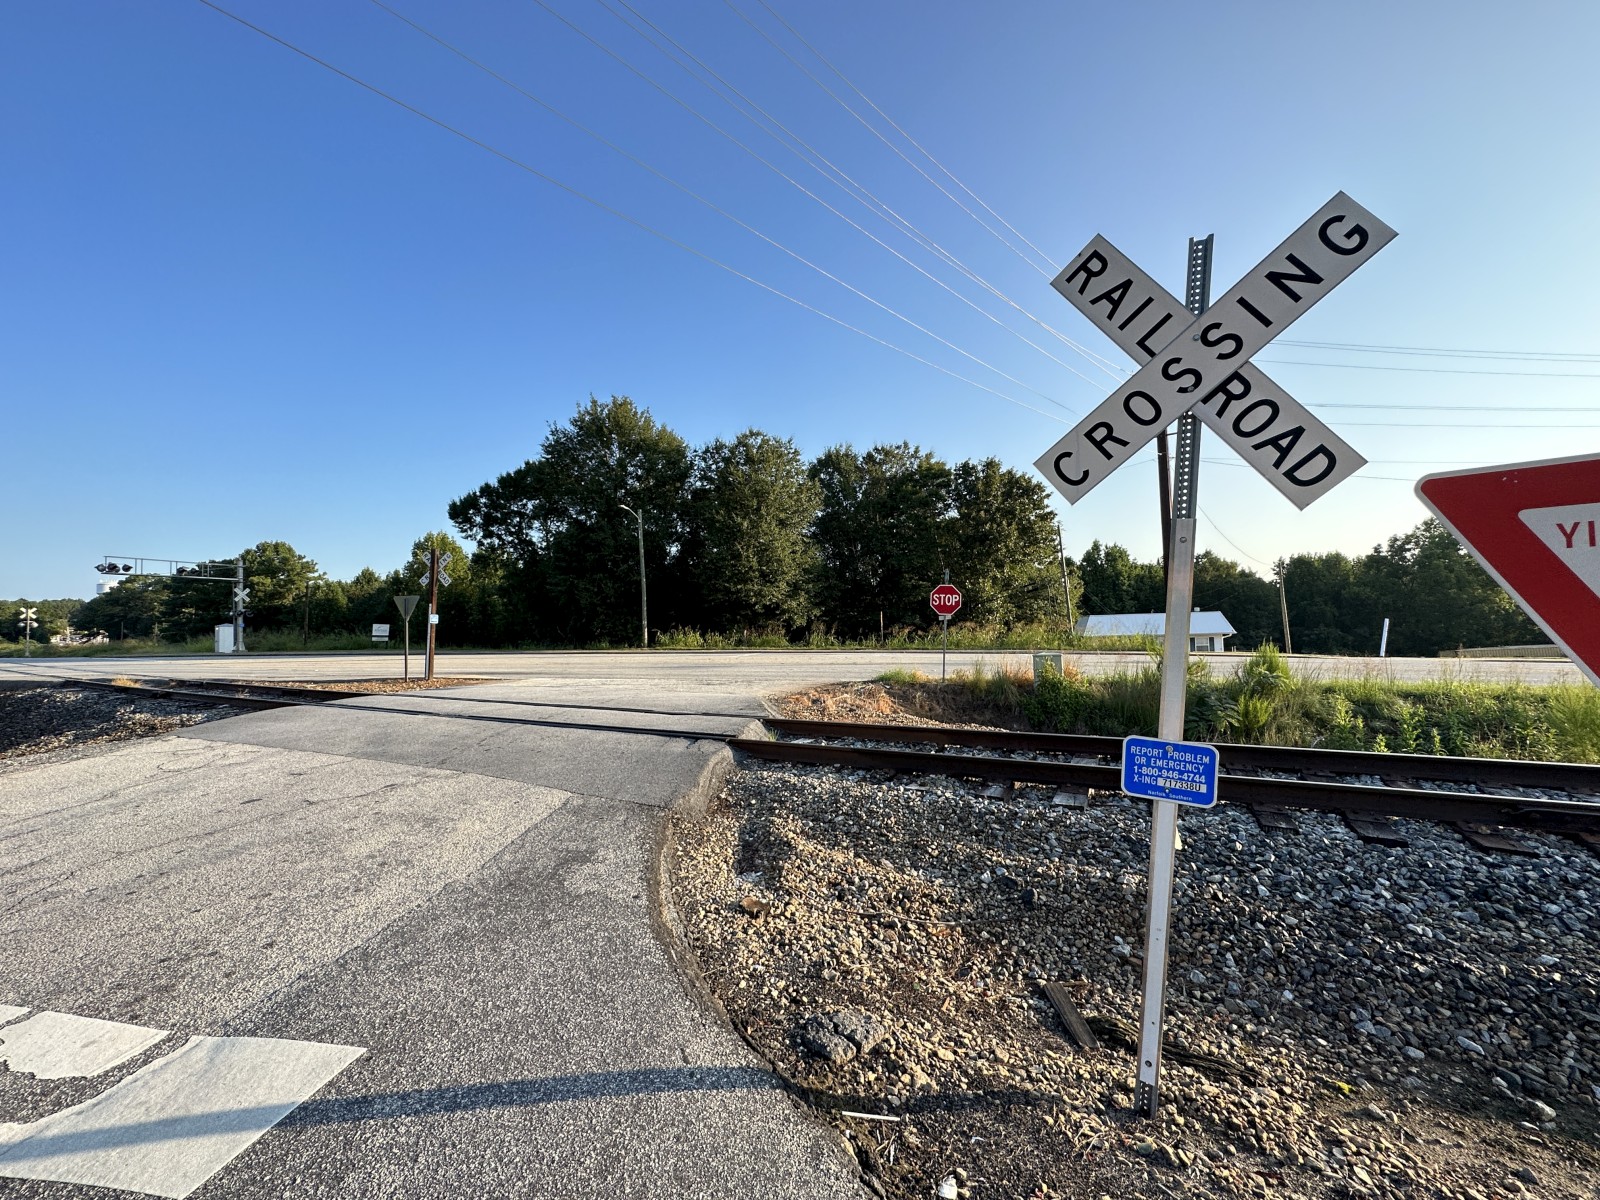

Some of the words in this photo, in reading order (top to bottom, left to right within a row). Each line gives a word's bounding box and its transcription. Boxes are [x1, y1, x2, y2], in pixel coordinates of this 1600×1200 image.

[1053, 214, 1369, 487] CROSSING
[1065, 249, 1173, 358] RAIL
[1201, 370, 1337, 487] ROAD
[1556, 520, 1597, 548] YI
[932, 594, 959, 606] STOP
[1130, 746, 1163, 757] REPORT
[1167, 750, 1210, 764] PROBLEM
[1134, 756, 1146, 765] OR
[1151, 758, 1204, 773] EMERGENCY
[1133, 766, 1206, 783] 1-800-946-4744
[1133, 774, 1157, 785] X-ING
[1169, 793, 1193, 801] Southern
